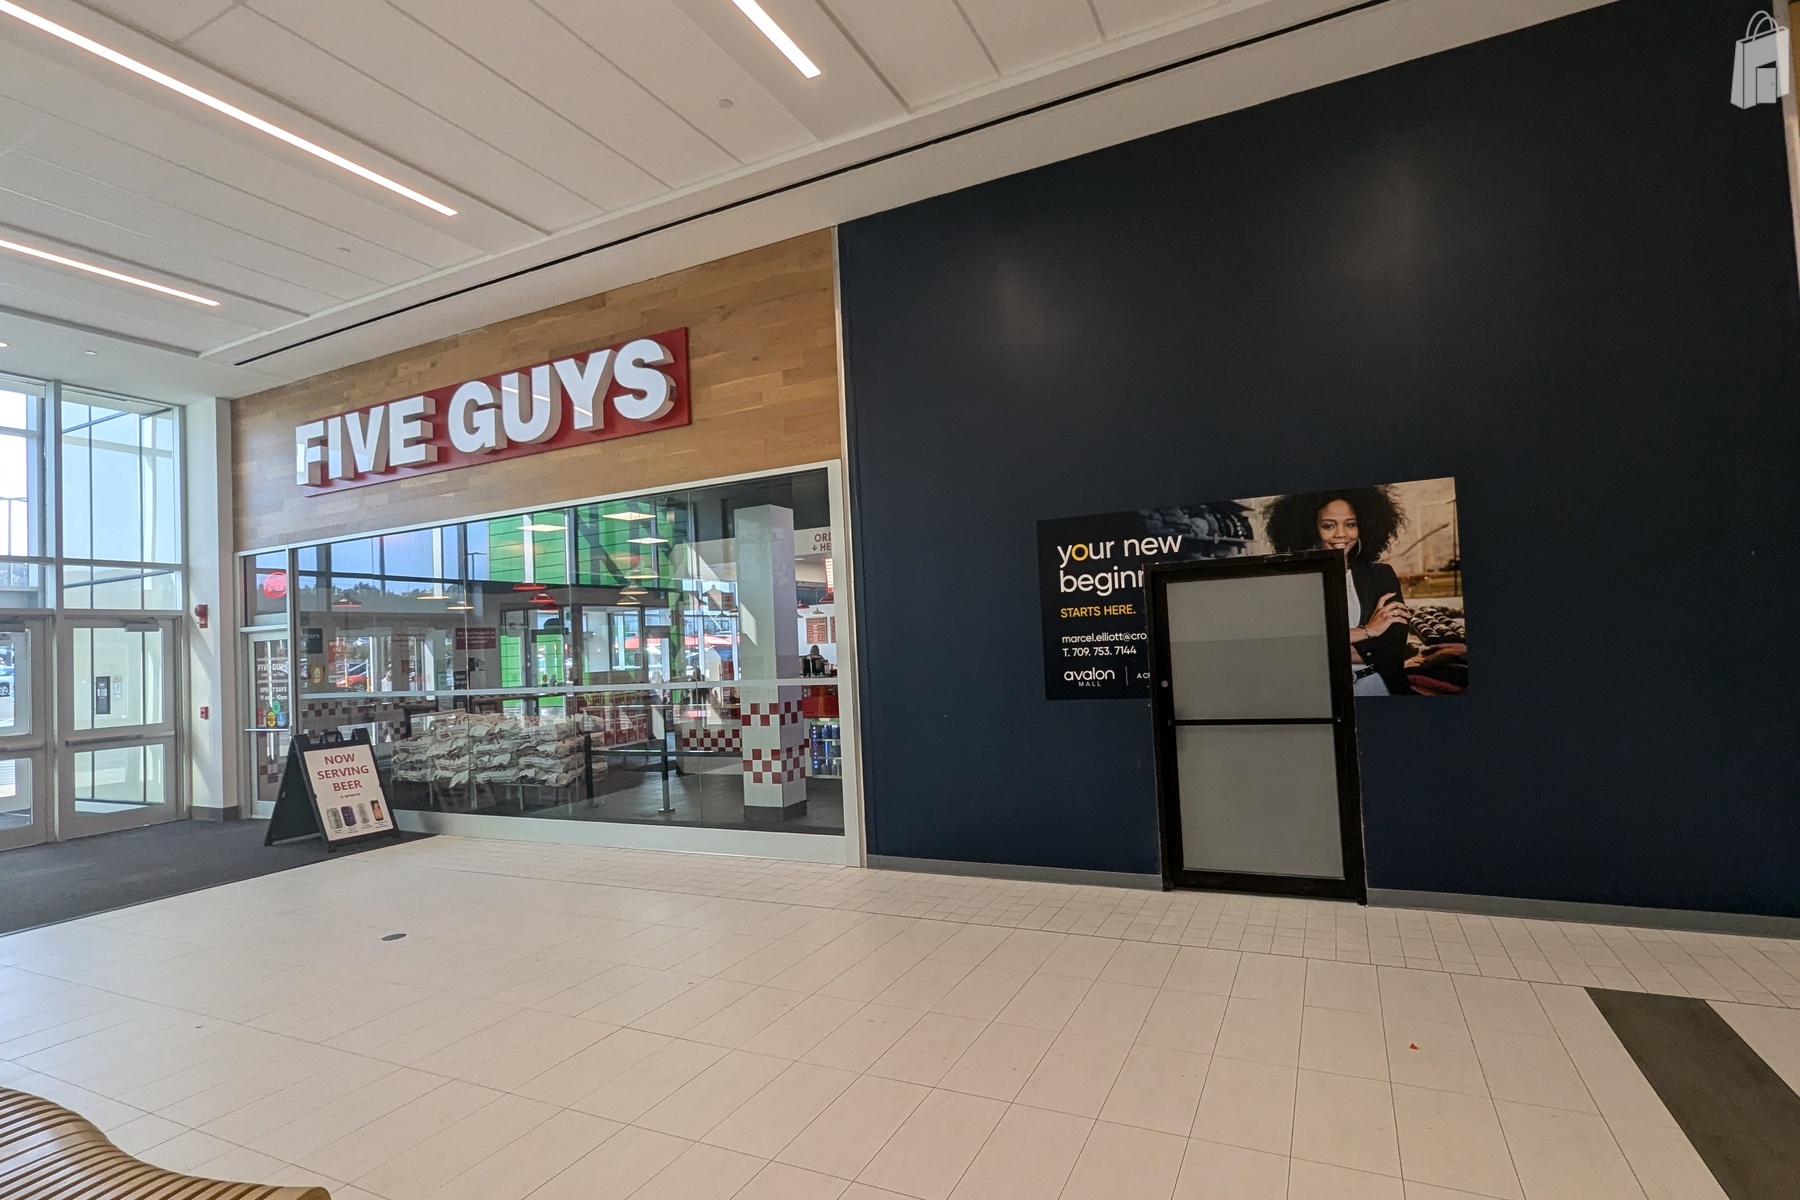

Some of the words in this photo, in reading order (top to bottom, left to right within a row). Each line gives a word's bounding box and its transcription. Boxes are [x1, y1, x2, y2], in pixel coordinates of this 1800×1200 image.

[296, 396, 438, 486] FIVE
[447, 339, 677, 455] GUYS
[1057, 541, 1115, 569] your
[1123, 535, 1183, 557] new
[1061, 606, 1101, 618] STARTS
[1104, 604, 1136, 616] HERE.
[1062, 632, 1147, 644] marcel.elliott@cro
[1062, 648, 1071, 657] T.
[1072, 647, 1091, 657] 709.
[1093, 646, 1112, 656] 753.
[1114, 645, 1137, 655] 7144
[1063, 667, 1116, 681] avalon
[324, 753, 355, 766] NOW
[317, 765, 370, 780] SERVING
[332, 780, 363, 792] BEER
